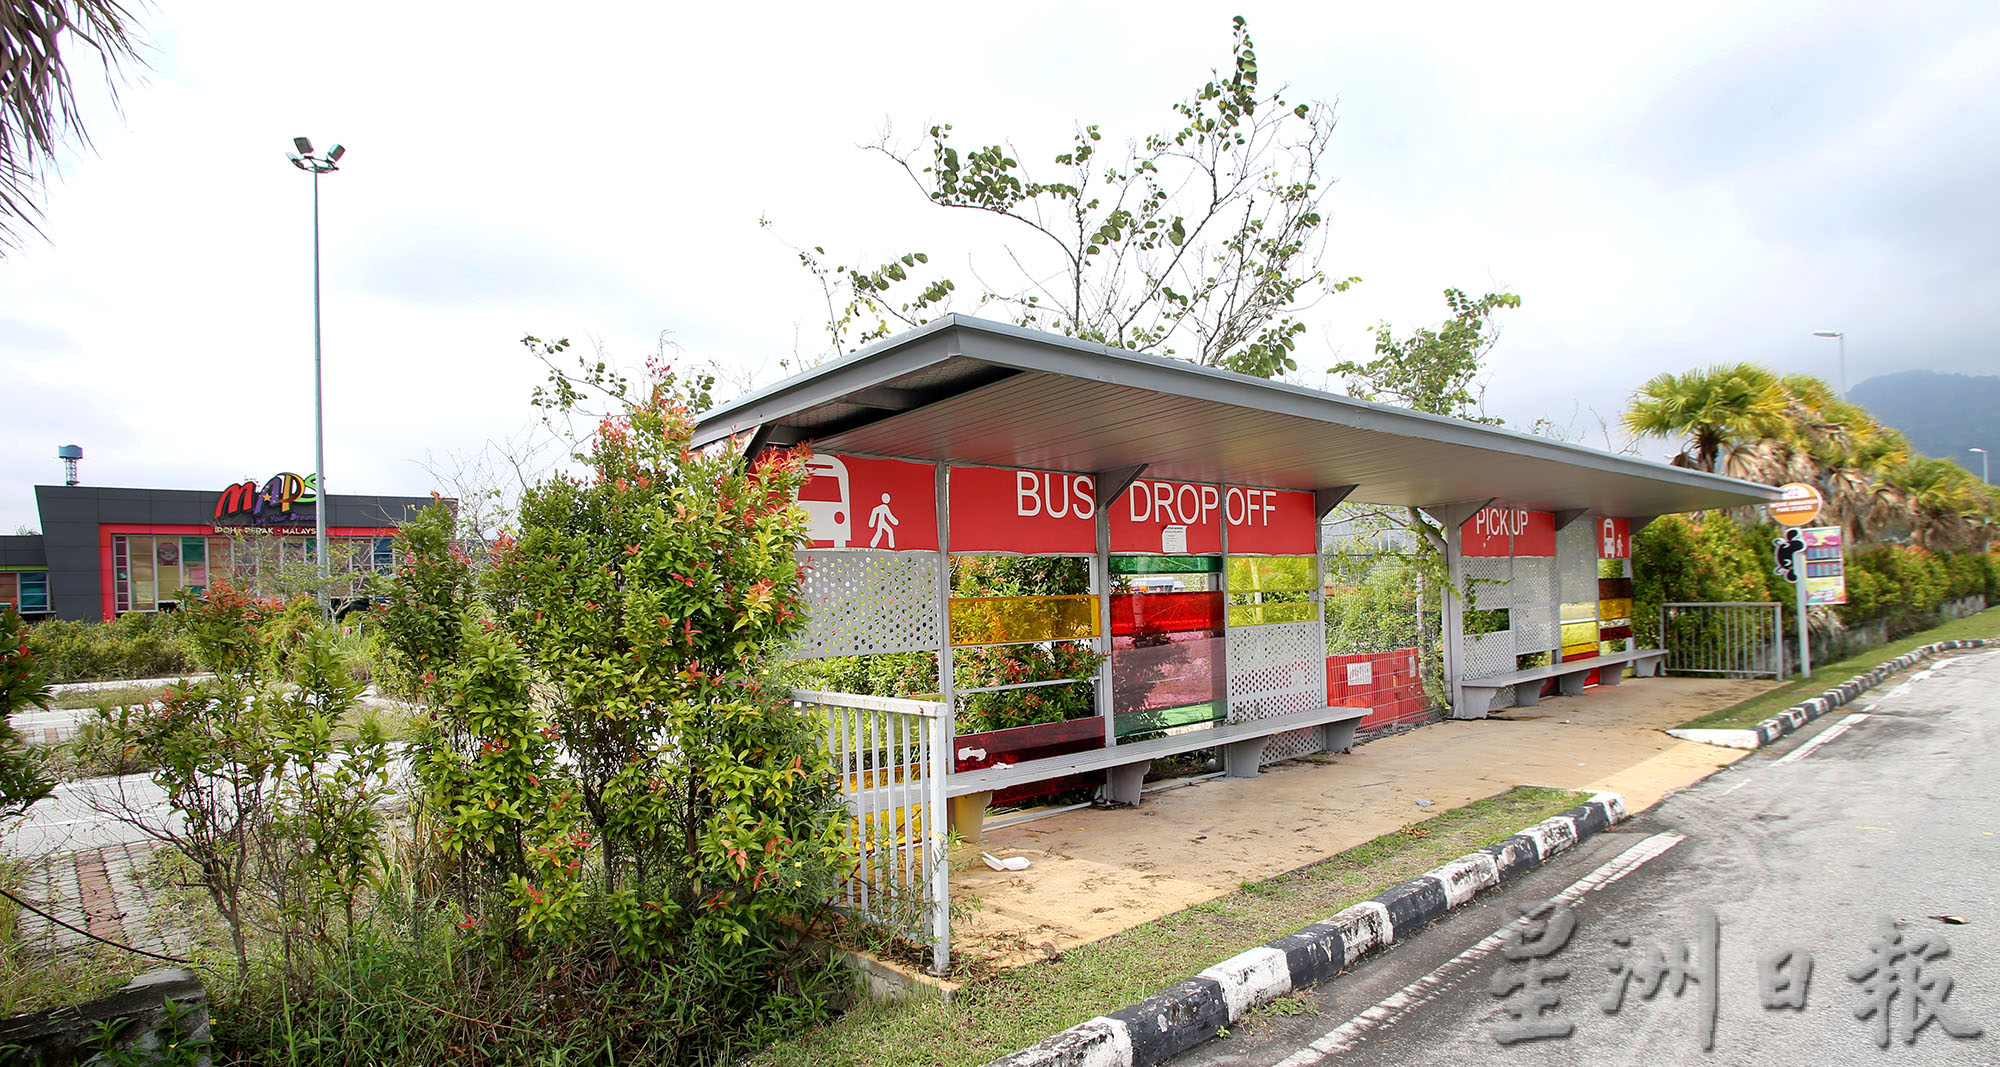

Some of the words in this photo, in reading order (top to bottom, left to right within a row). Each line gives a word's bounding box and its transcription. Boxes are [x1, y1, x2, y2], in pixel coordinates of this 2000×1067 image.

[1016, 471, 1096, 520] BUS
[1129, 480, 1219, 525] DROP
[1225, 487, 1277, 527] OFF
[282, 527, 317, 535] MALAYS
[1476, 508, 1510, 536] PICK
[1511, 509, 1529, 536] UP
